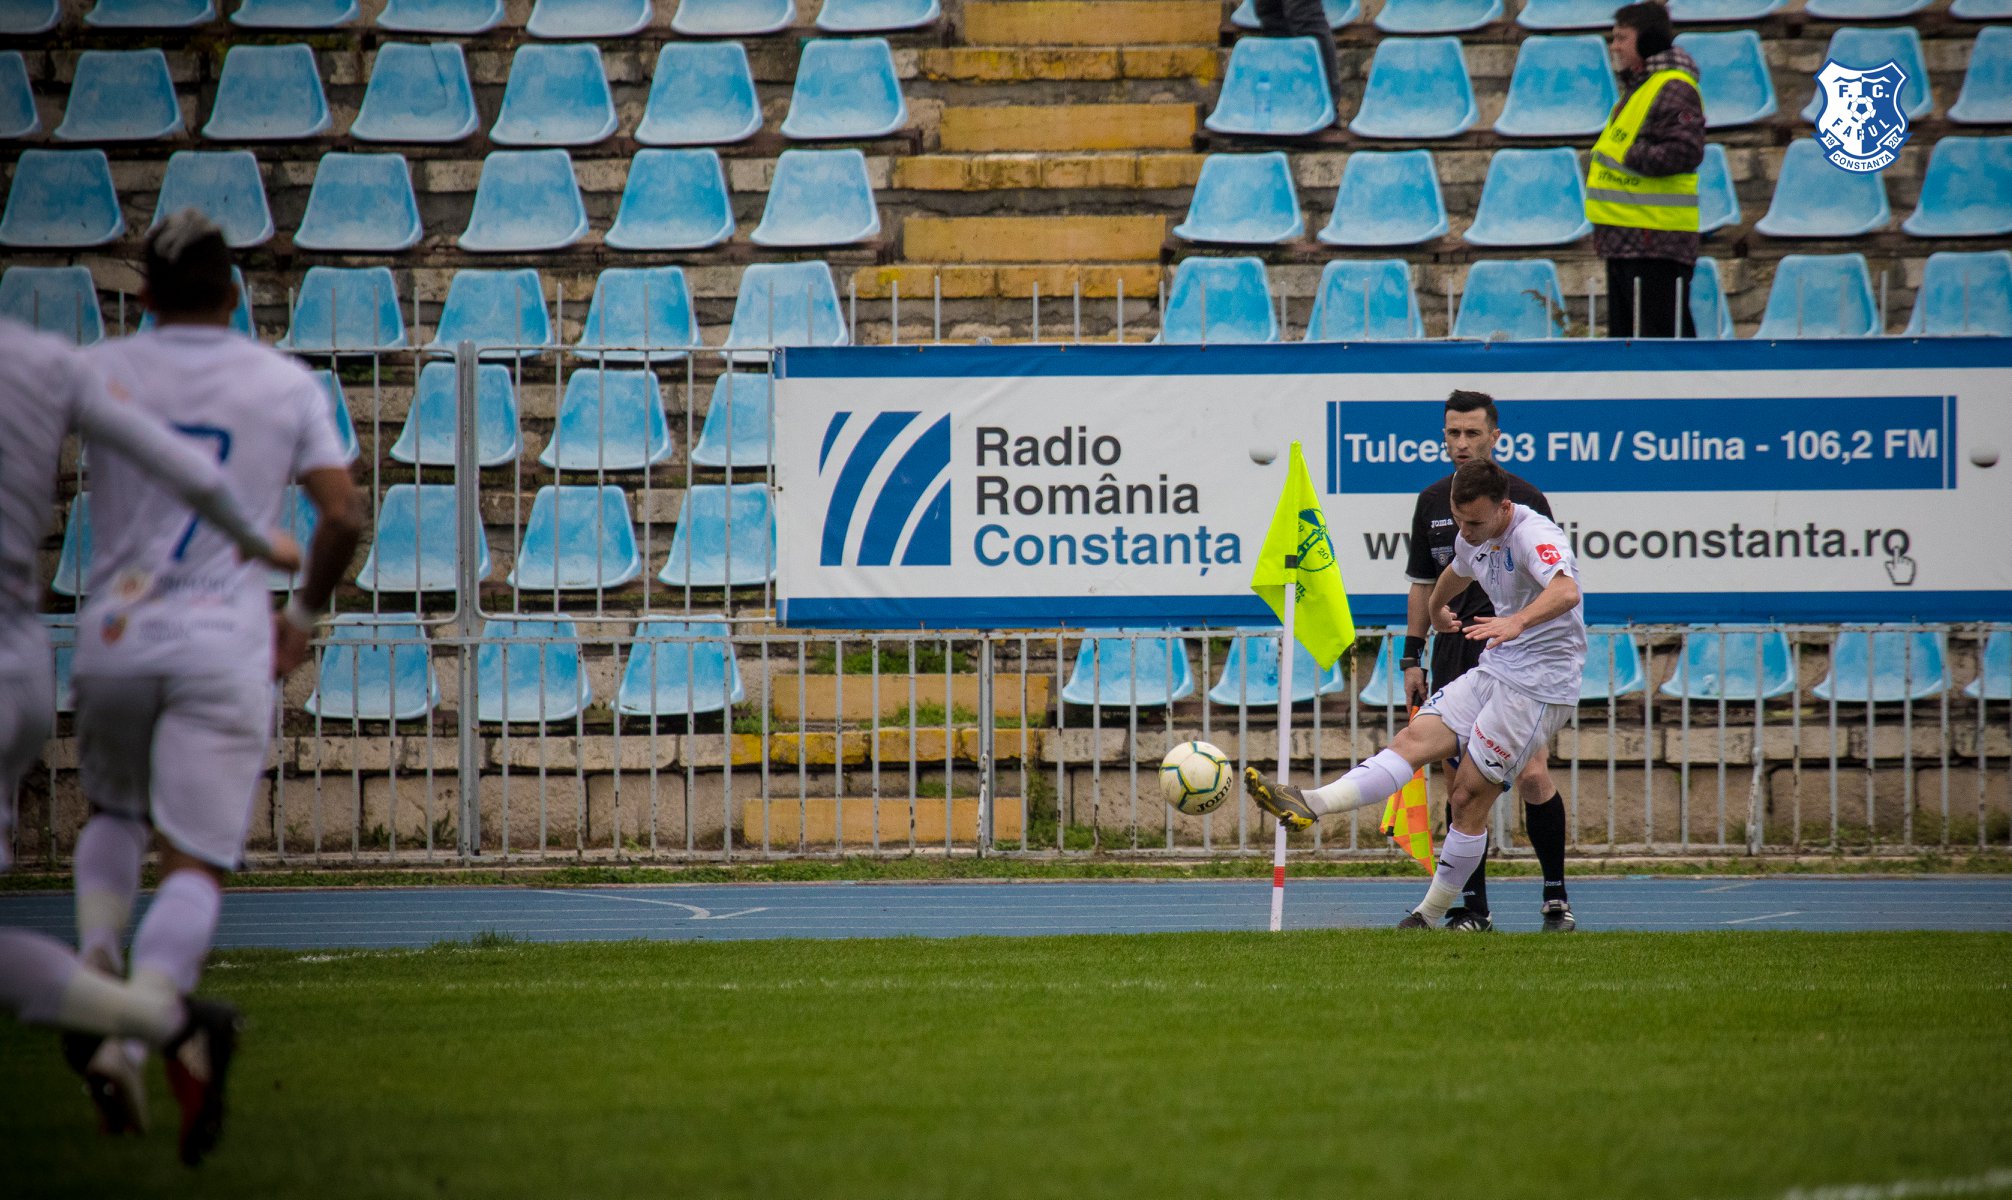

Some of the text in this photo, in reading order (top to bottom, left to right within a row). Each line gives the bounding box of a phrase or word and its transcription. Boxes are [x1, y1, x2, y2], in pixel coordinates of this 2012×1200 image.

[975, 425, 1122, 468] Radio
[1494, 432, 1535, 463] 93
[1548, 432, 1602, 462] FM
[1609, 431, 1624, 463] /
[1632, 431, 1746, 462] Sulina
[1781, 430, 1873, 464] 106,2
[1885, 429, 1938, 459] FM
[169, 421, 232, 561] 7
[975, 472, 1201, 517] România
[973, 523, 1243, 578] Constanța
[1317, 548, 1330, 561] 20
